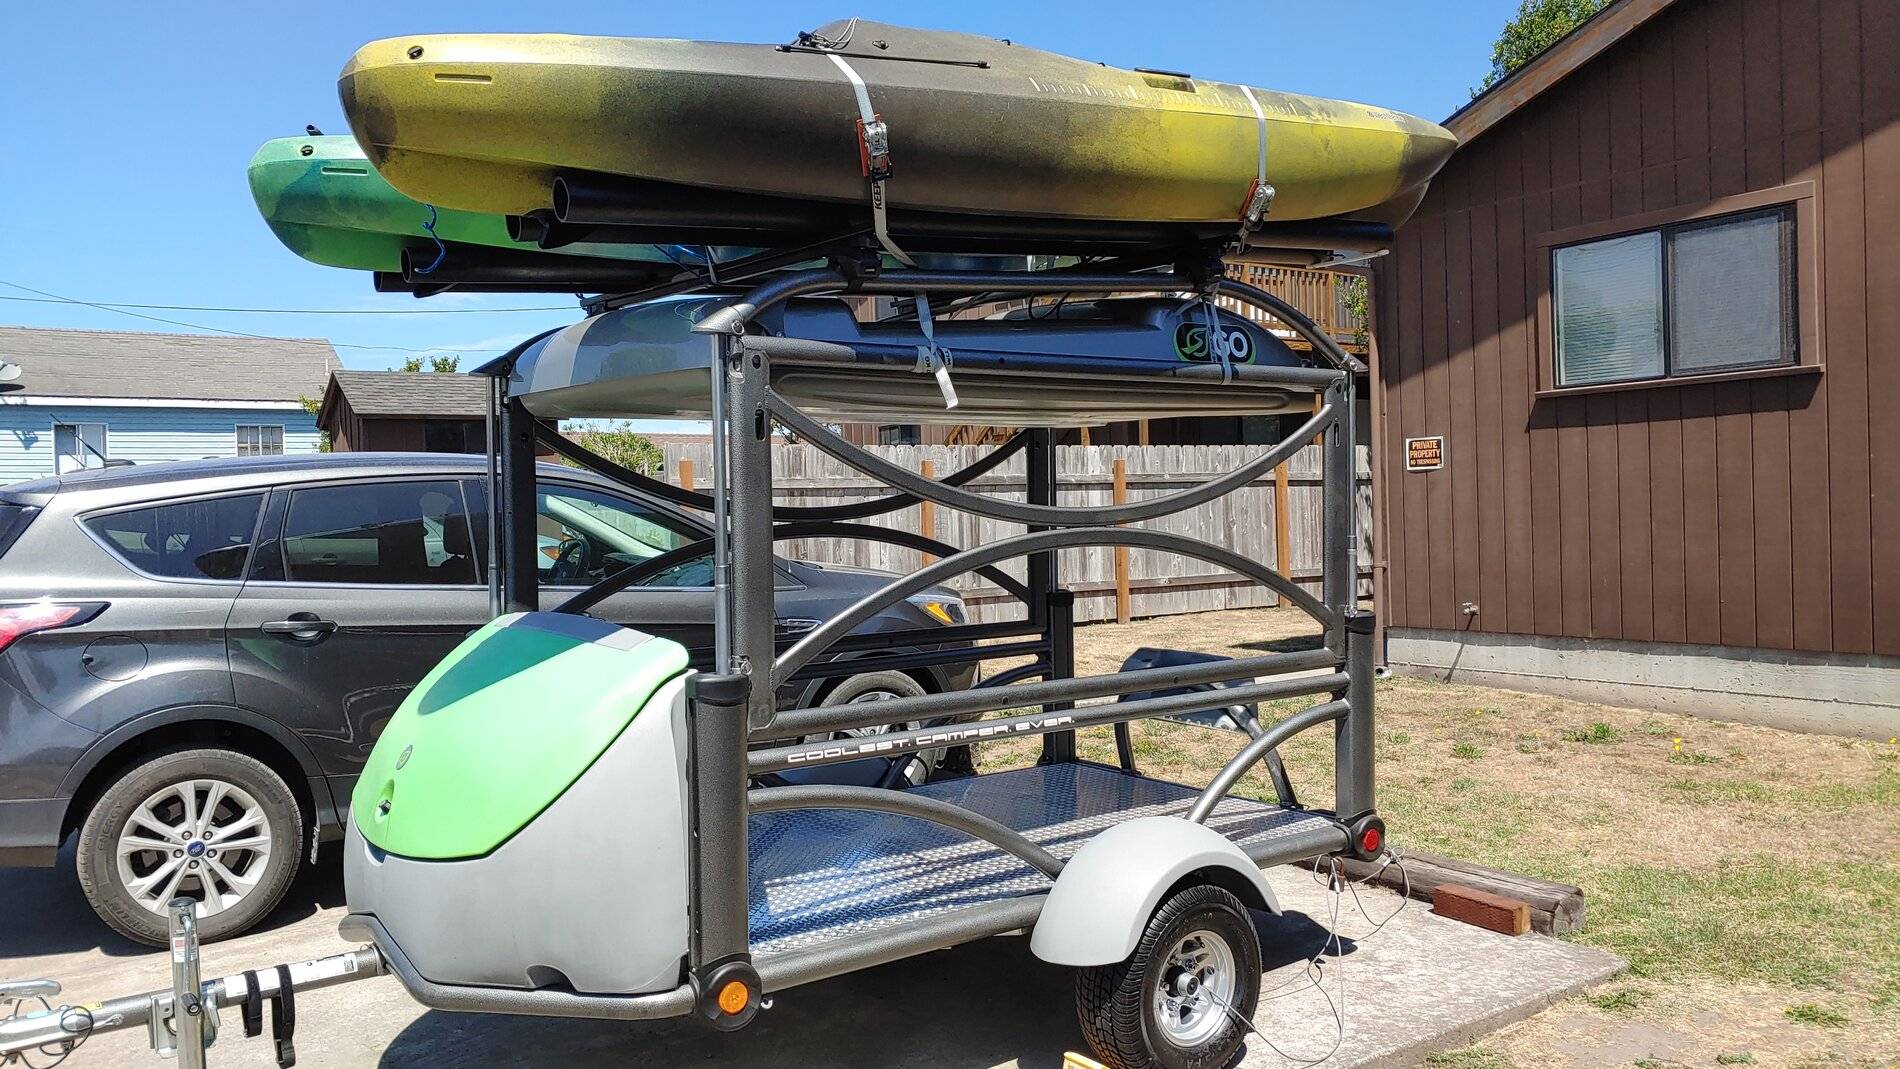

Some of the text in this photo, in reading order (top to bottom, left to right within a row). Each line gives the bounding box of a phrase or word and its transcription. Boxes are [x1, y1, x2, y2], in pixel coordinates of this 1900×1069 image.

[1410, 449, 1440, 459] PROPERTY
[1412, 440, 1438, 449] PRIVATE
[788, 716, 1075, 763] COOLEST. CAMPER. EVER.
[97, 801, 120, 851] ENERGY
